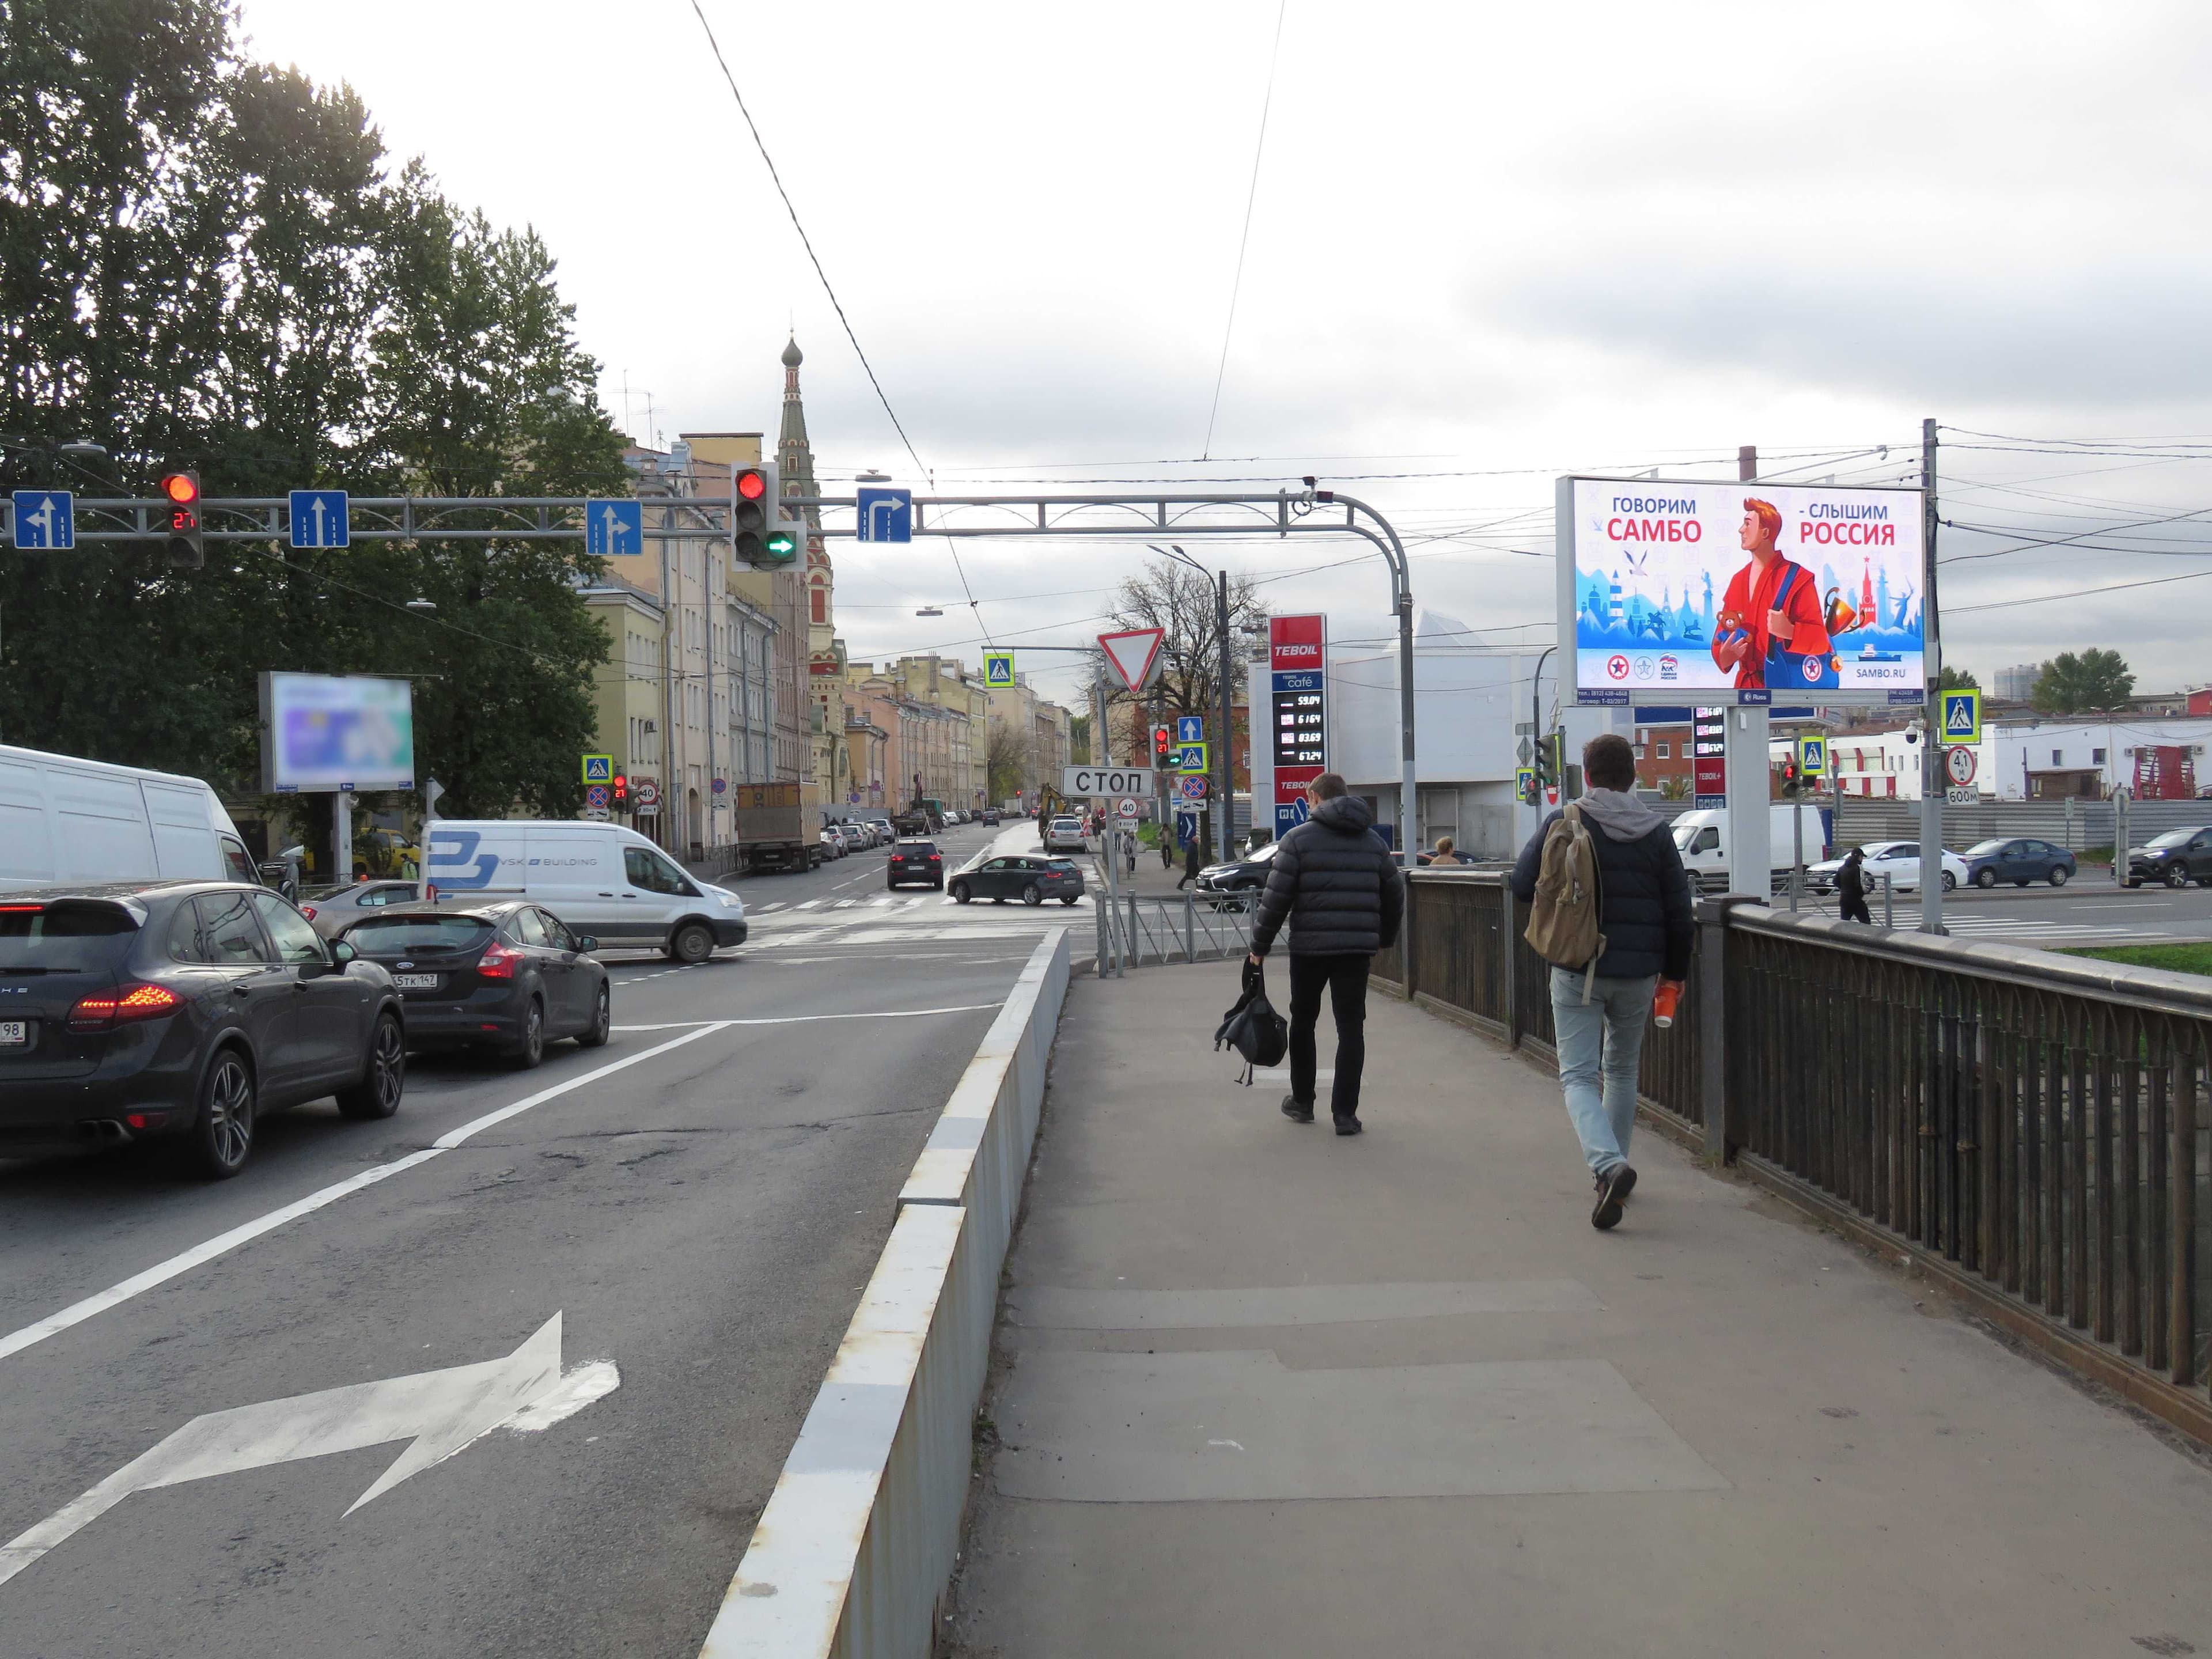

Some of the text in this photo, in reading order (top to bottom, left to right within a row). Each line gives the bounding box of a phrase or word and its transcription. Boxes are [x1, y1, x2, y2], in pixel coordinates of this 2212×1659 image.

[1613, 497, 1696, 514] ГОВОРИМ
[1809, 503, 1888, 520] СЛЫШИМ
[1607, 518, 1702, 543] САМБО
[1801, 521, 1895, 546] РОССИЯ
[1275, 645, 1317, 656] TEBOIL
[1857, 669, 1906, 678] SAMBO.RU
[1287, 676, 1312, 688] café
[1298, 696, 1320, 705] 59.04
[1298, 733, 1321, 743] 83.69
[1158, 744, 1167, 752] 27
[1299, 751, 1321, 761] 67.24
[1076, 772, 1141, 793] СТОП
[615, 789, 625, 798] 27
[641, 789, 653, 797] 40
[1122, 804, 1134, 812] 40
[419, 975, 434, 983] 147
[3, 1024, 19, 1036] 98
